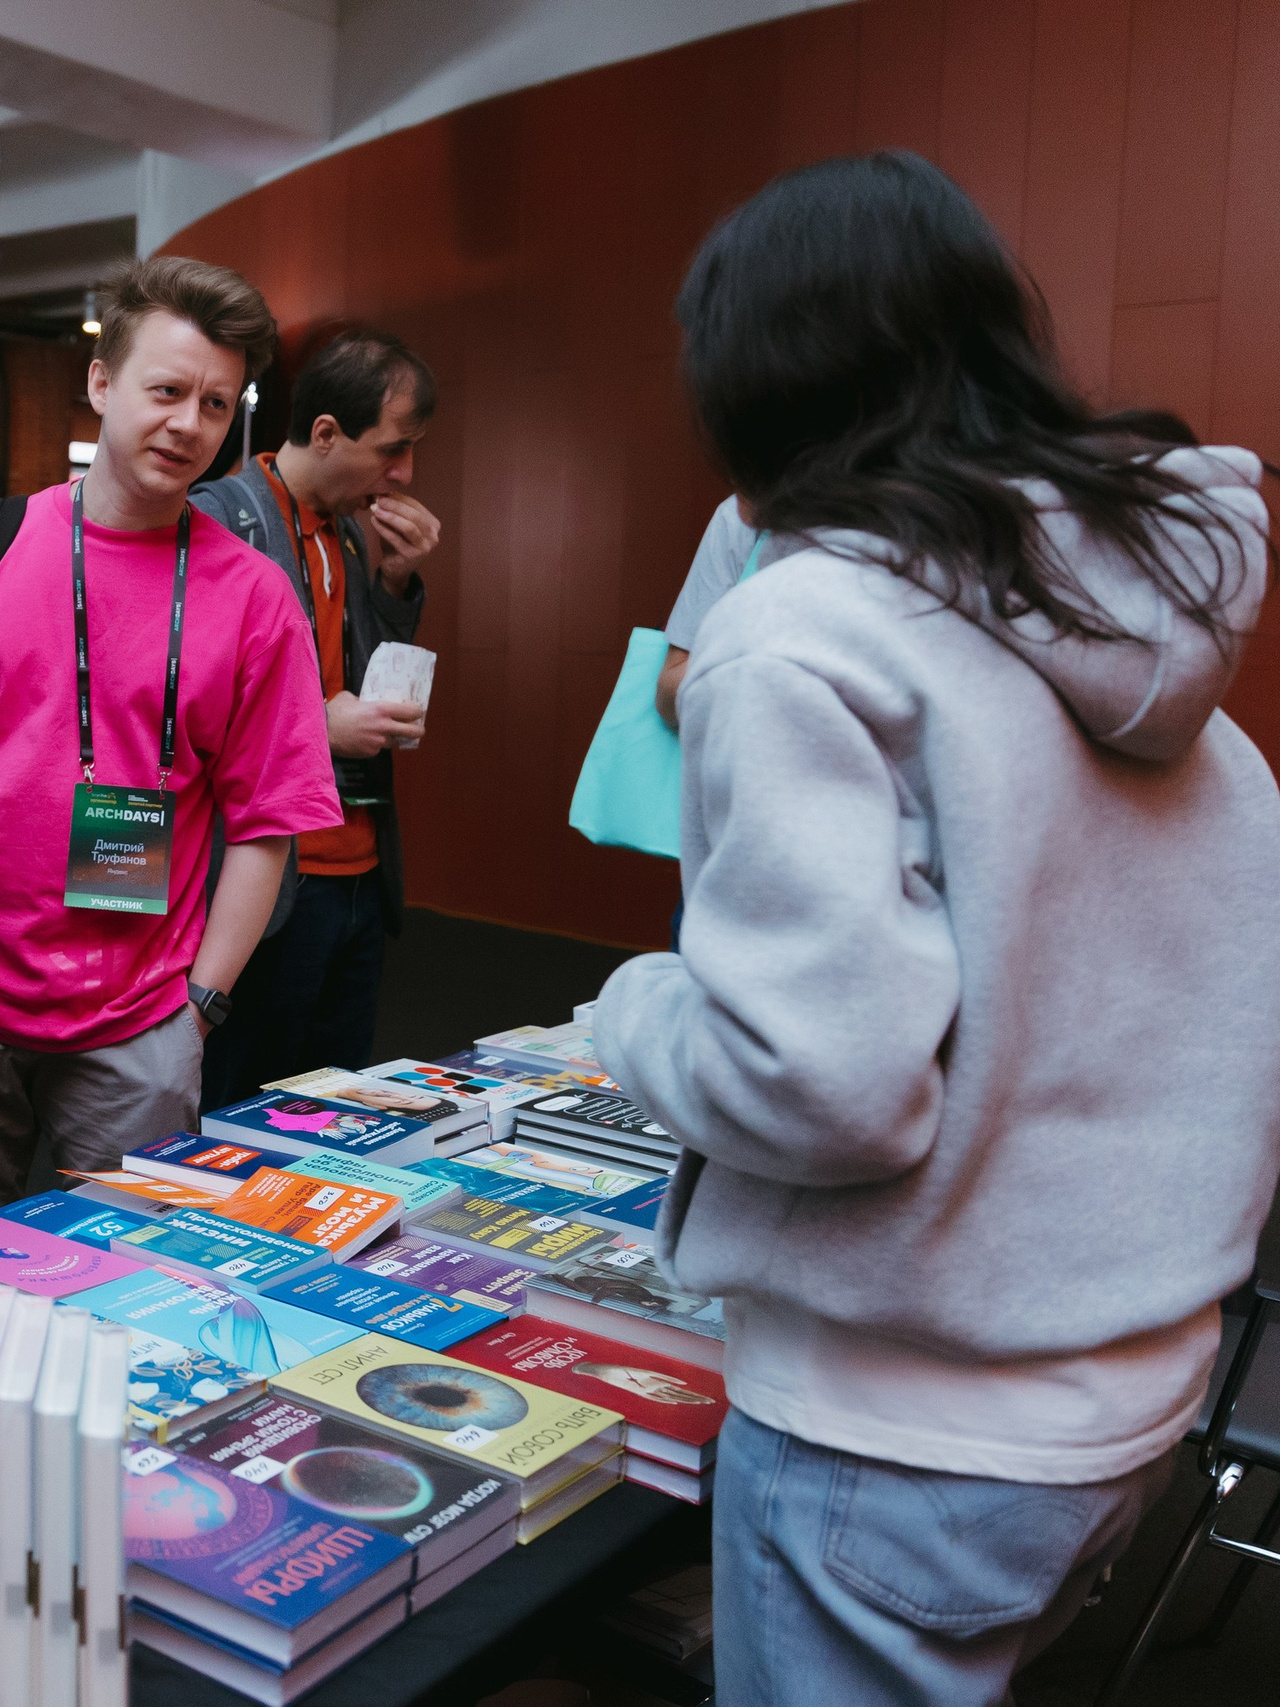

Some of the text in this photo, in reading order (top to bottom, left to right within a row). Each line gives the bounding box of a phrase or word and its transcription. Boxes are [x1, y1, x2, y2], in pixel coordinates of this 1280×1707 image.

[91, 851, 147, 865] Труфанов
[94, 839, 144, 853] Дмитрий
[90, 898, 143, 910] УЧАСТНИК
[303, 1162, 375, 1183] человека
[310, 1158, 415, 1186] об эволюции
[320, 1153, 367, 1168] Мифы
[88, 1221, 124, 1236] 52
[164, 1218, 253, 1247] жизни
[182, 1211, 315, 1256] Происхождение
[311, 1205, 354, 1238] мозг
[315, 1197, 387, 1247] Музыка
[397, 1248, 457, 1278] начинался
[411, 1244, 442, 1260] язык
[446, 1252, 474, 1265] Как
[480, 1268, 530, 1293] Эверетт
[125, 1285, 214, 1320] ВЫГОРАНИЯ
[188, 1294, 243, 1315] ЖИЗНЬ
[380, 1302, 442, 1331] НАВЫКОВ
[430, 1298, 464, 1313] 7
[308, 1345, 388, 1386] АНИЛ СЕТ
[511, 1342, 572, 1372] СИМВОЛЫ
[543, 1348, 588, 1369] КРОВЬ
[251, 1403, 295, 1427] НАУКИ
[208, 1408, 308, 1462] С ТОЧКИ ЗРЕНИЯ
[240, 1413, 322, 1459] СНОВИДЕНИЯ
[497, 1405, 601, 1466] БЫТЬ СОБОЙ
[456, 1478, 502, 1508] КОГДА
[428, 1503, 466, 1529] МОЗГ
[243, 1526, 374, 1606] ШИФРЫ
